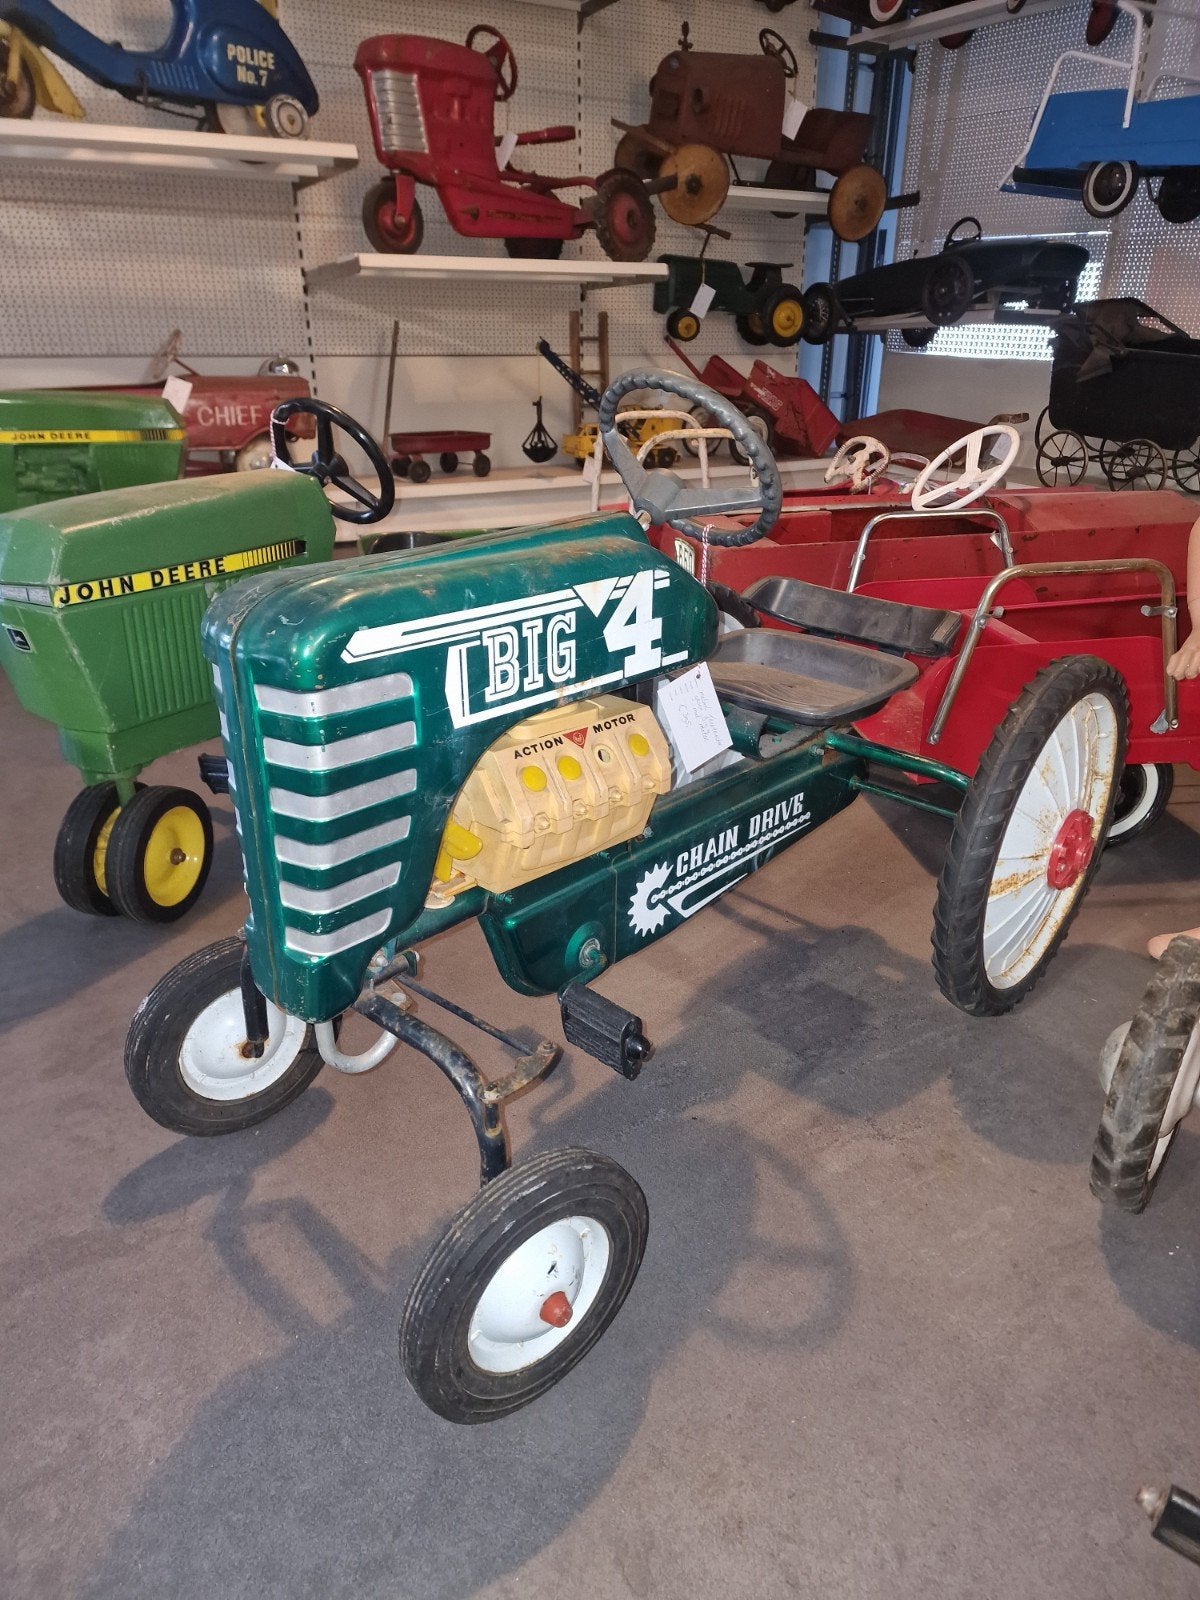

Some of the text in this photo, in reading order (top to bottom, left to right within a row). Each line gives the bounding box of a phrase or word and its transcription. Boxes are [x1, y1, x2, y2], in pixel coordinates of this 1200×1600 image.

[227, 43, 275, 70] POLICE
[236, 64, 268, 87] No. 7
[197, 405, 262, 427] CHIEF
[11, 431, 91, 441] JOHN DEERE
[59, 557, 226, 604] JOHN DEERE
[482, 569, 662, 703] BIG 4
[514, 713, 636, 759] ACTION MOTOR
[675, 792, 804, 877] CHAIN DRIVE
